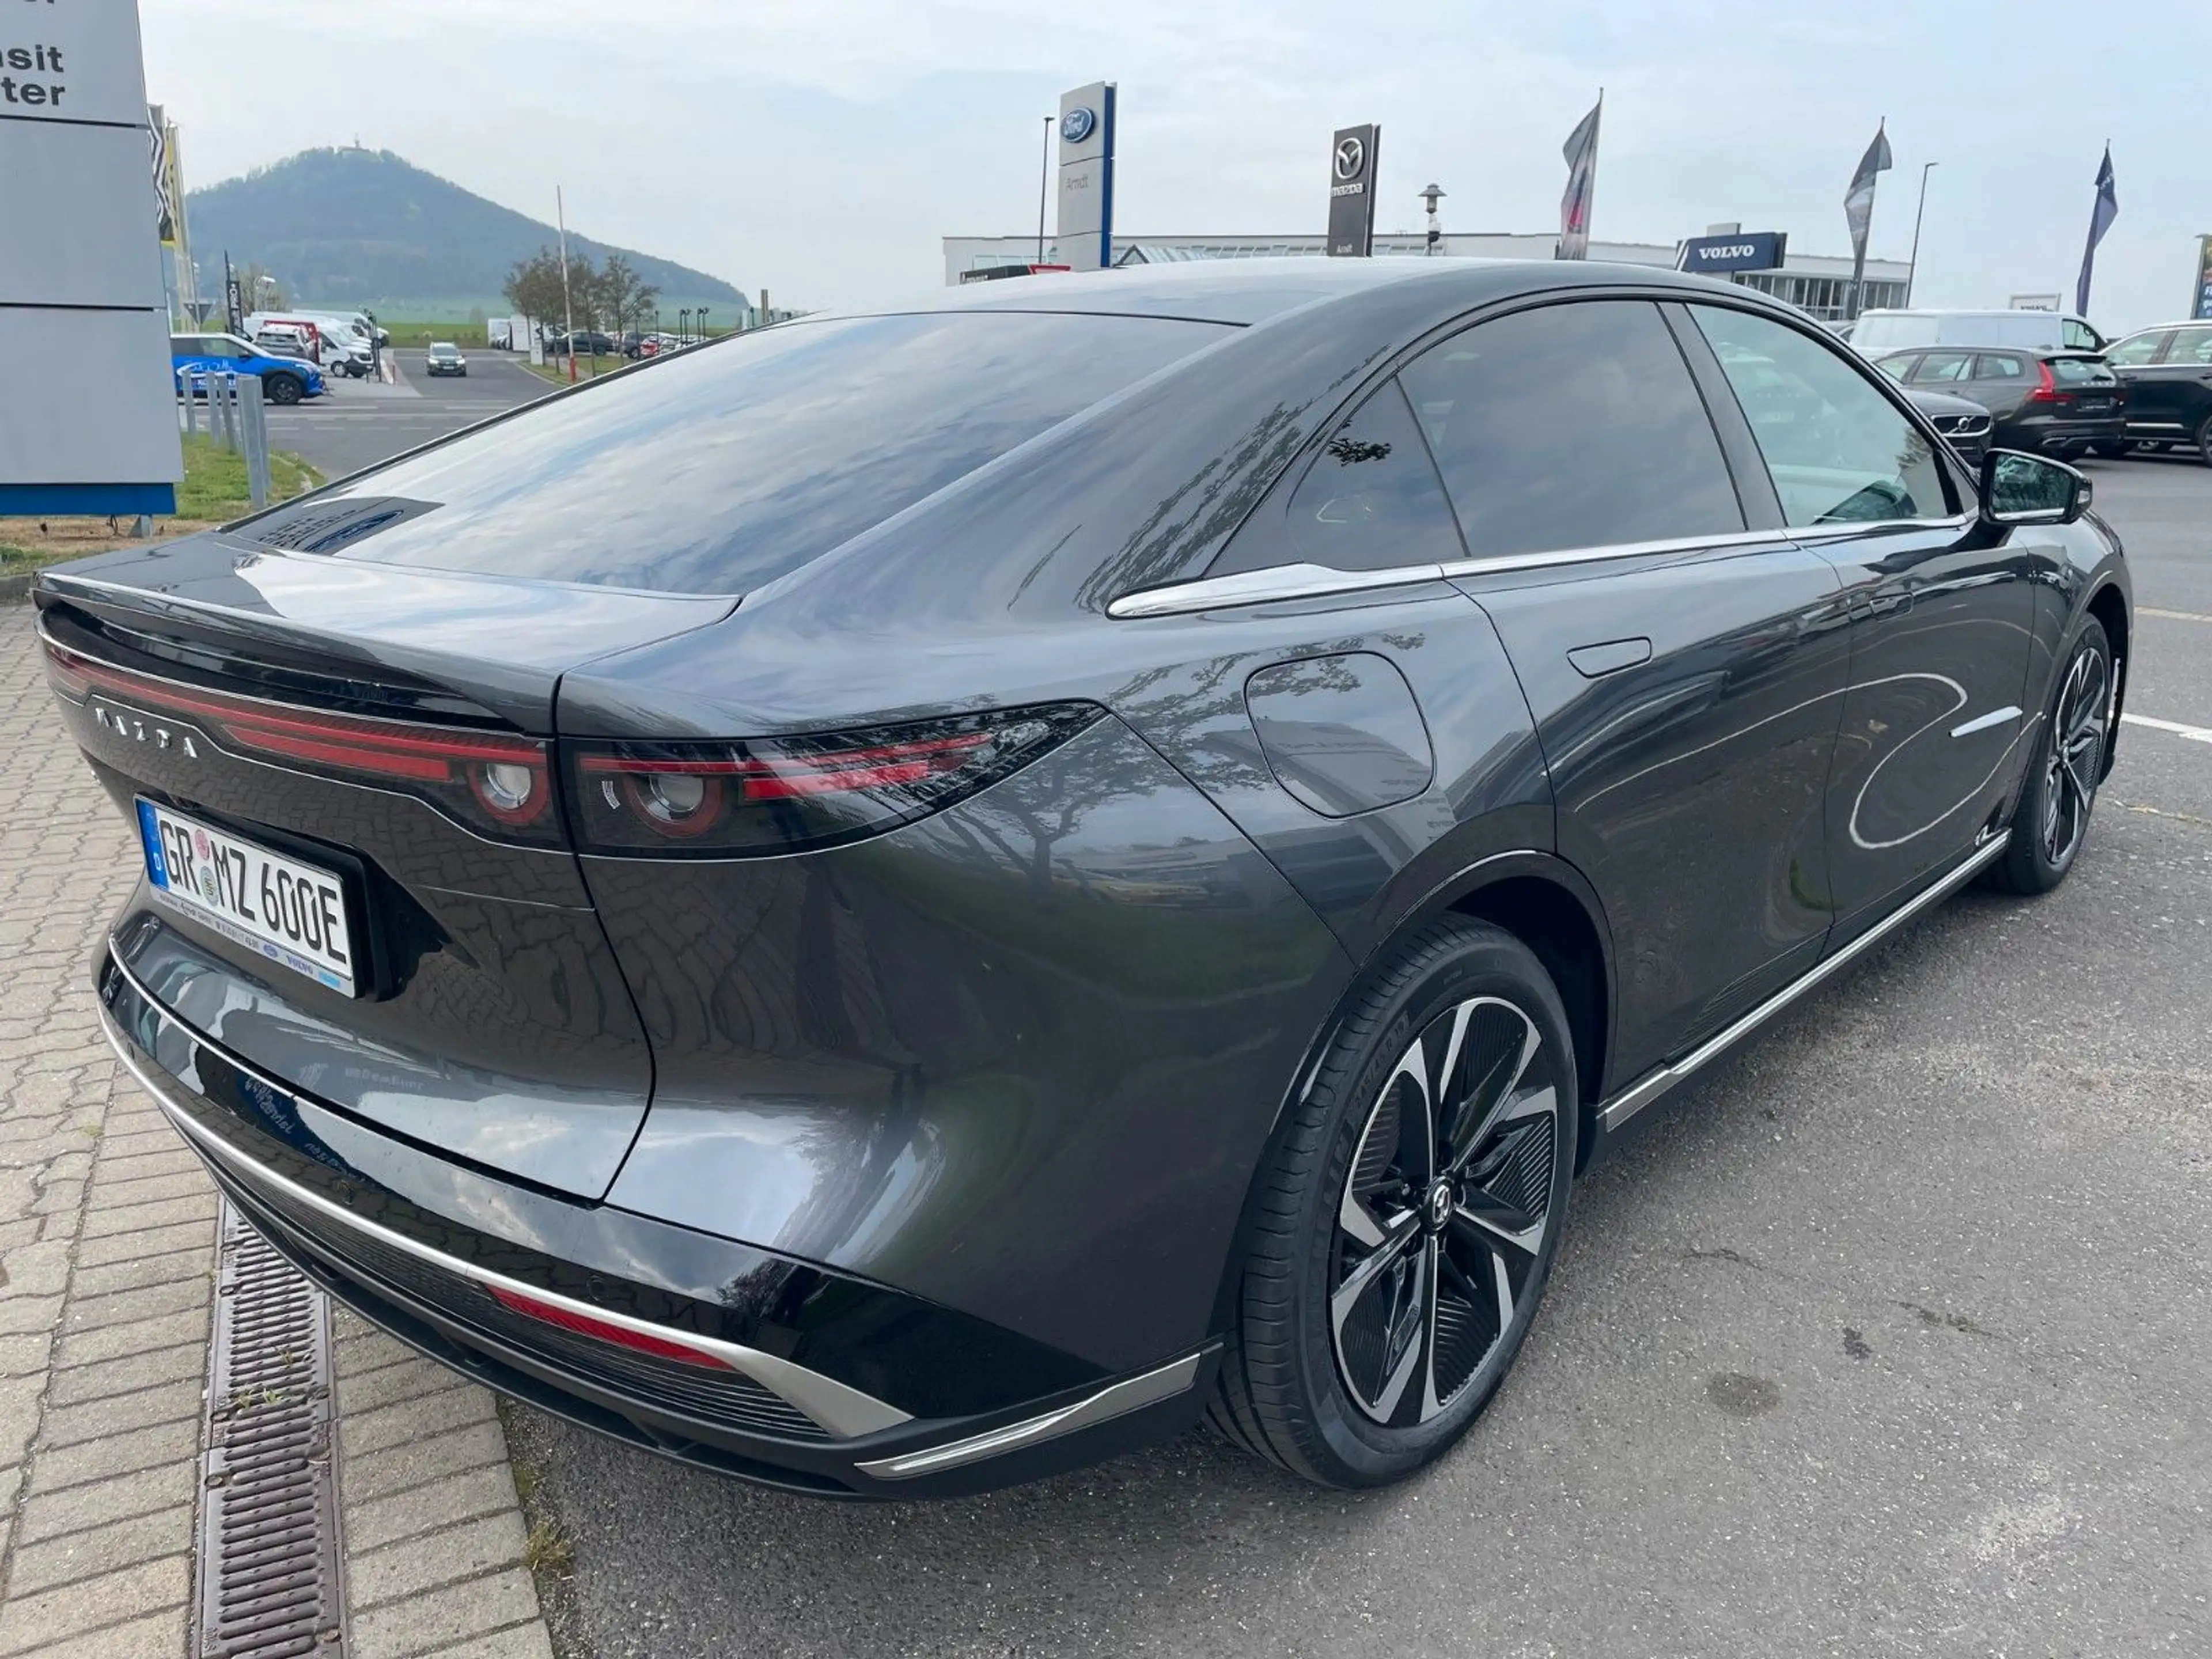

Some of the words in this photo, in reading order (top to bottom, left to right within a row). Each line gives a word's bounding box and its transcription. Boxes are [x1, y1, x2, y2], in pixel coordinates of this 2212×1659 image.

[1699, 244, 1755, 260] VOLVO
[95, 707, 198, 758] MAZDA
[159, 819, 200, 895] GR
[211, 840, 256, 922] MZ
[261, 862, 347, 965] 600E
